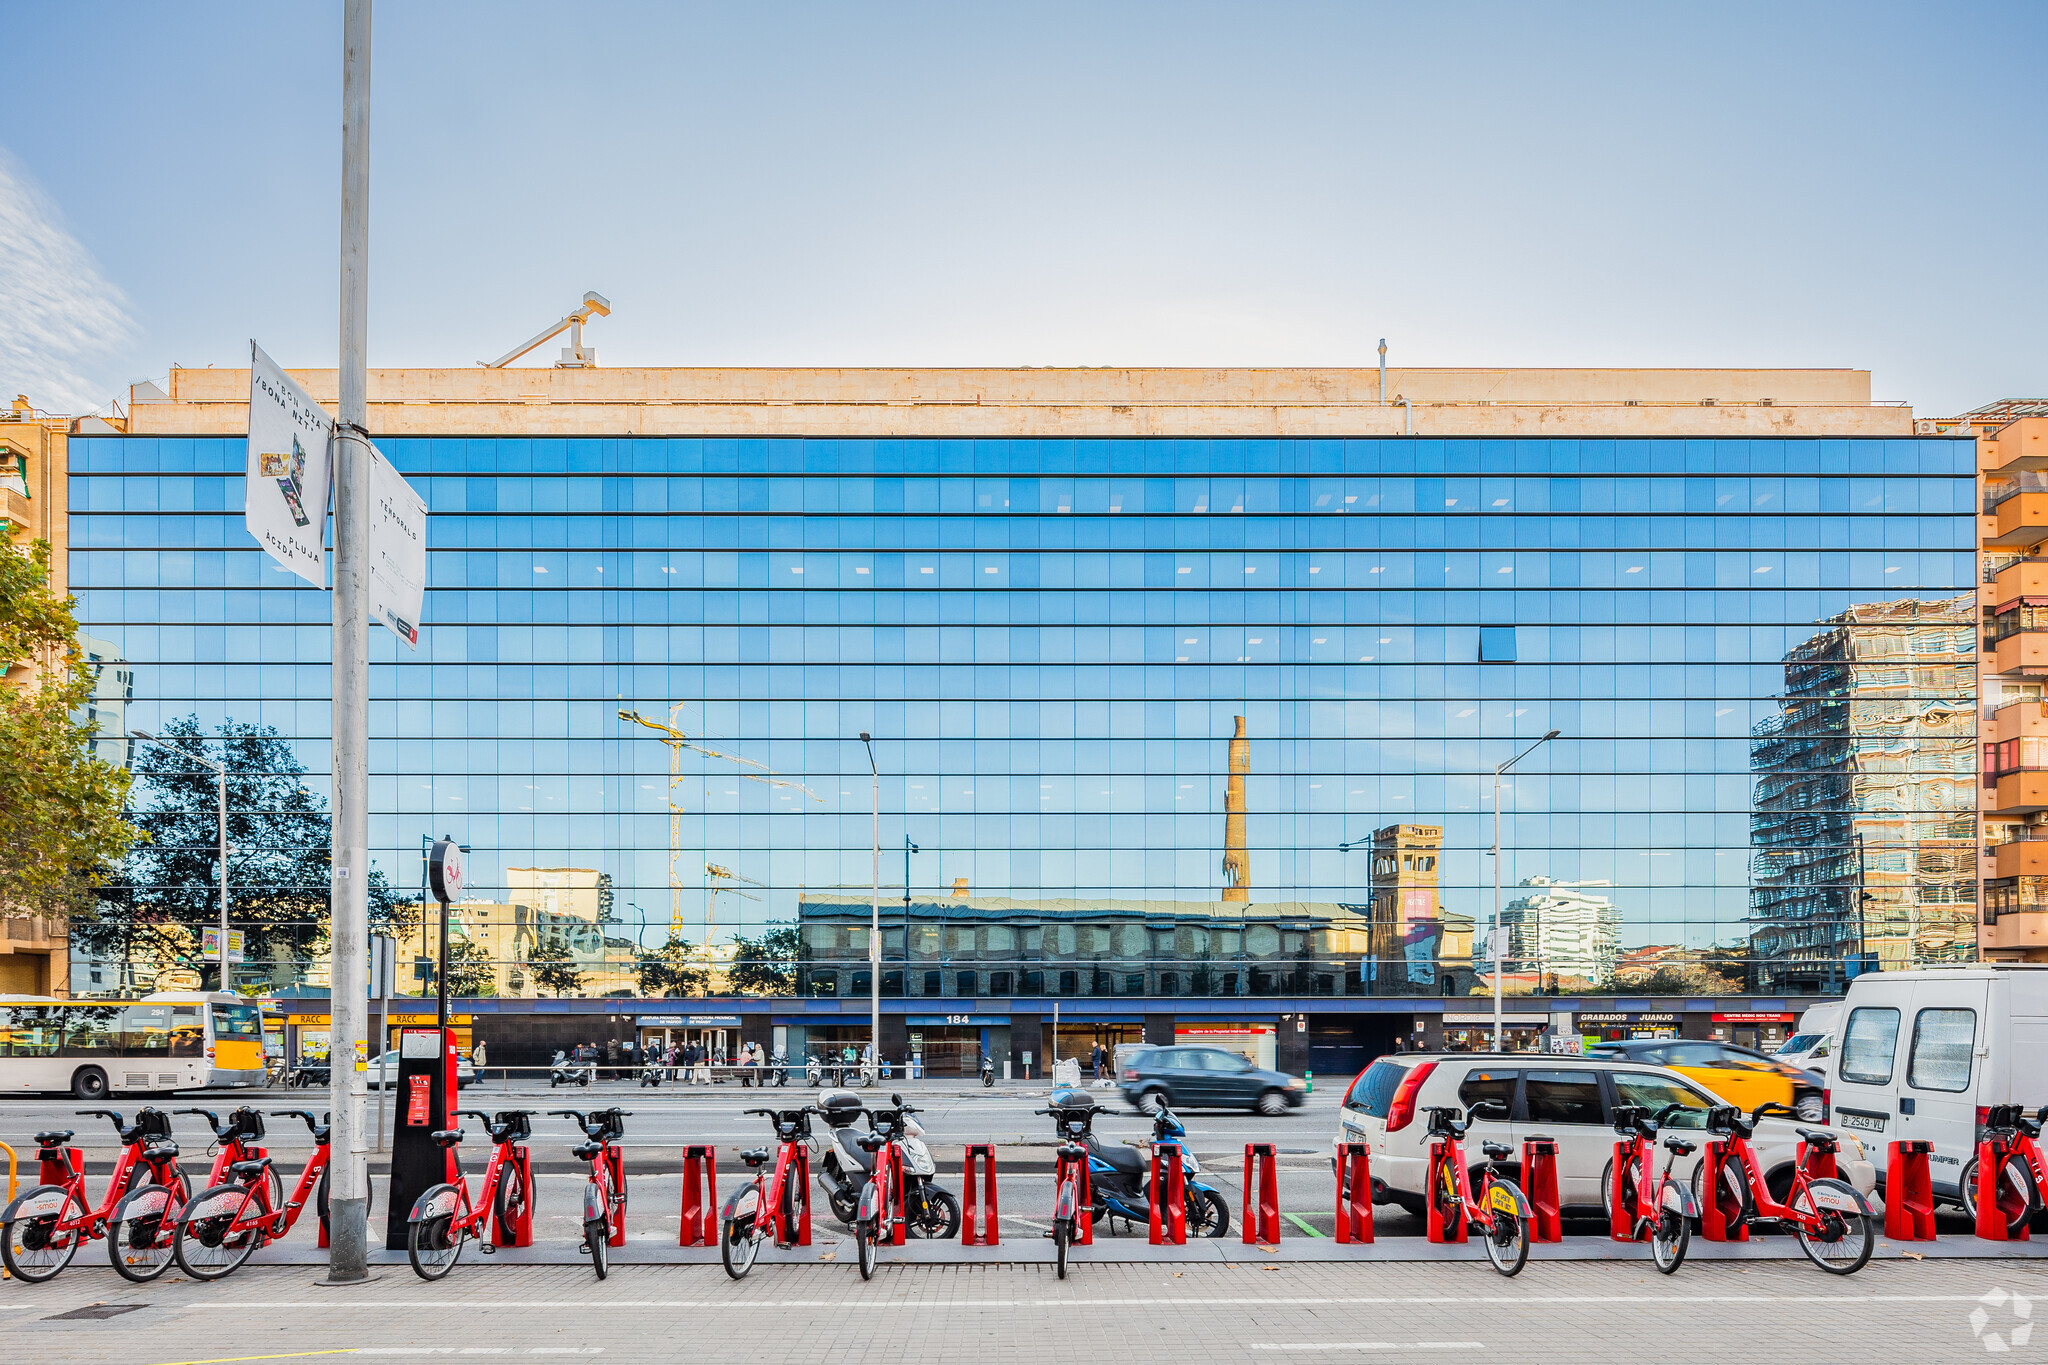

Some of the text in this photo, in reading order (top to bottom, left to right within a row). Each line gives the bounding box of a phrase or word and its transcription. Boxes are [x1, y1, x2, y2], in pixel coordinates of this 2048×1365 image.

[305, 408, 321, 430] DIA
[380, 498, 417, 540] TEMPORALS
[288, 536, 320, 564] PLUJA
[151, 1008, 165, 1017] 294
[1580, 1013, 1674, 1021] GRABADOS JUANJO
[300, 1015, 321, 1024] RACC
[396, 1015, 417, 1024] RACC
[946, 1014, 970, 1025] 184
[1928, 1153, 1960, 1166] UMPER
